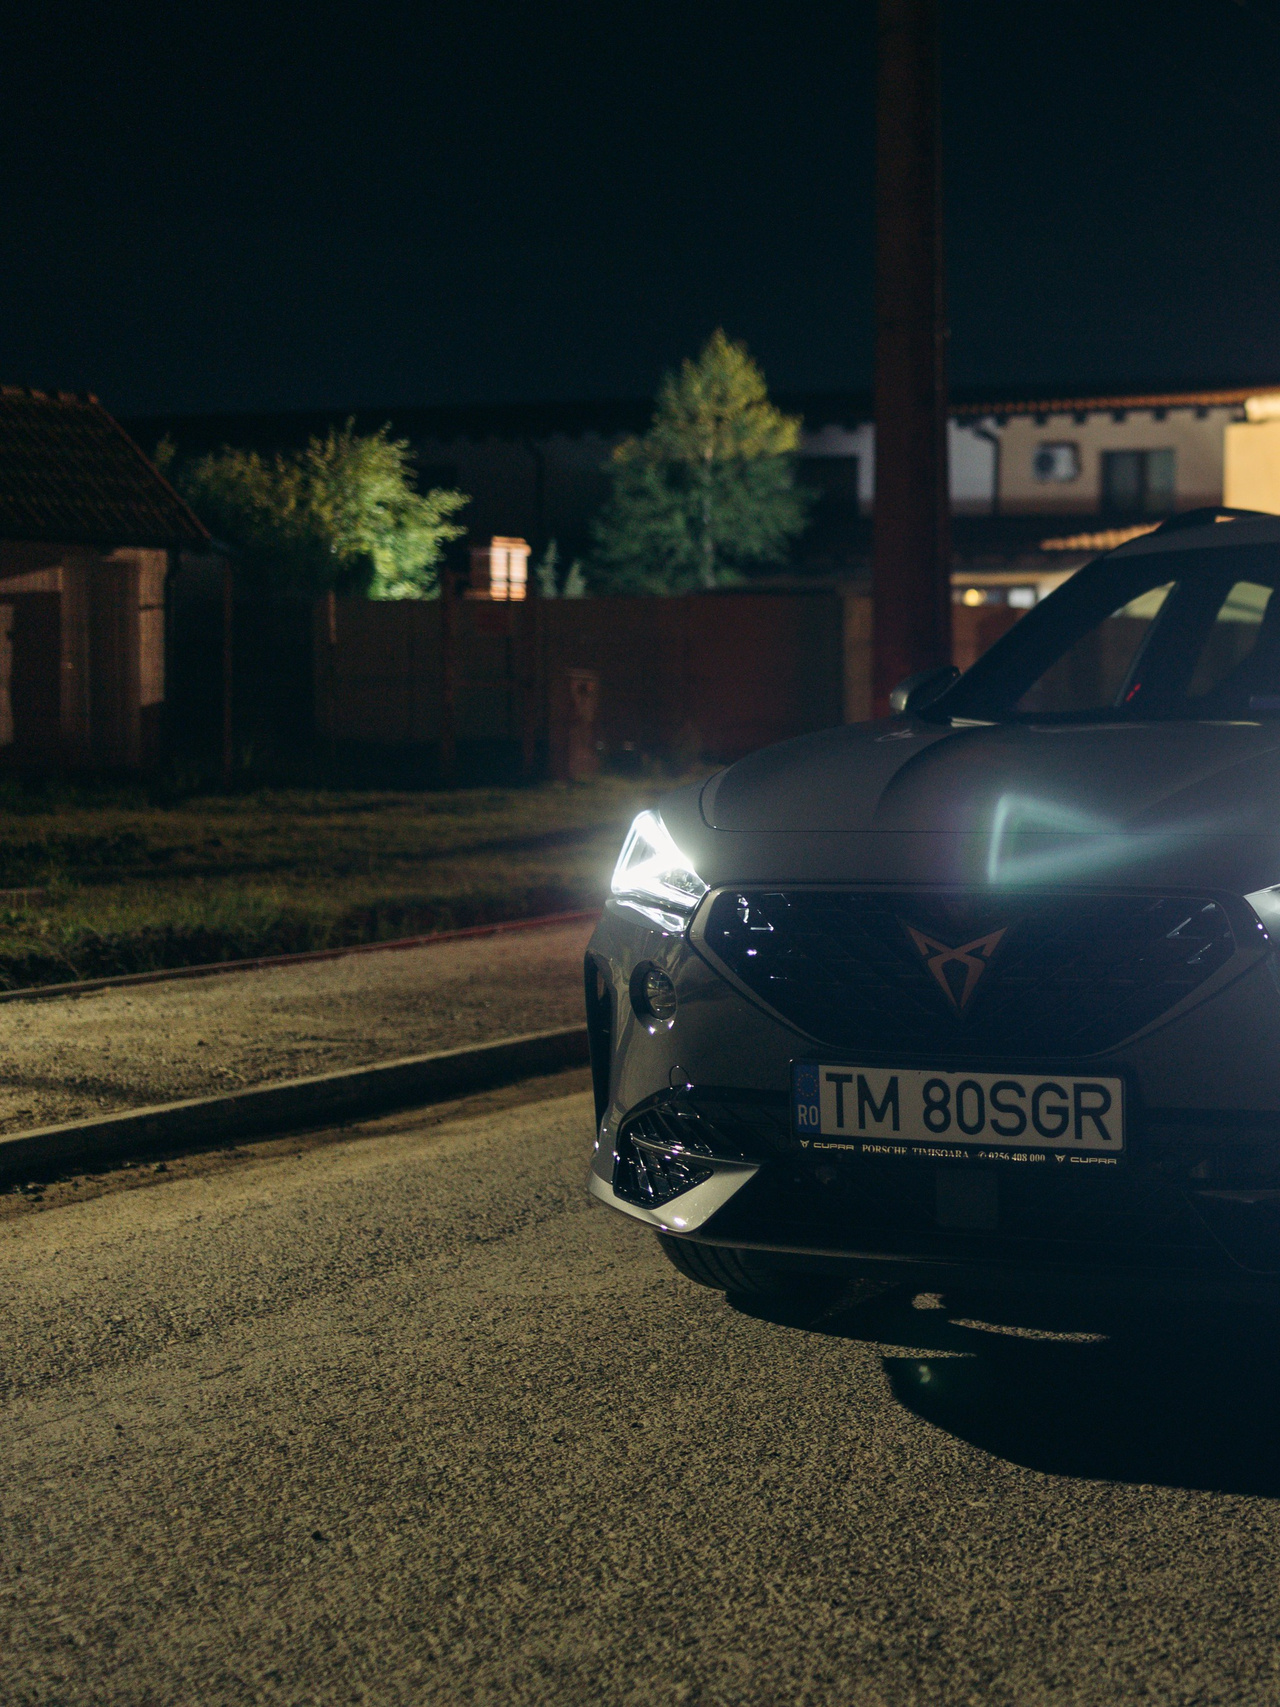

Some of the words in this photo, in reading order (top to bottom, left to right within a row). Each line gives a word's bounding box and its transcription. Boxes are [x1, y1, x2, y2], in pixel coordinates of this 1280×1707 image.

[797, 1104, 818, 1126] RO
[825, 1072, 900, 1132] TM
[922, 1077, 1112, 1141] 80SGR
[813, 1142, 854, 1151] CUPRA
[862, 1144, 907, 1154] PORSCHE
[1012, 1153, 1028, 1162] 408
[1030, 1153, 1046, 1163] 000
[1070, 1156, 1117, 1165] CUPRA
